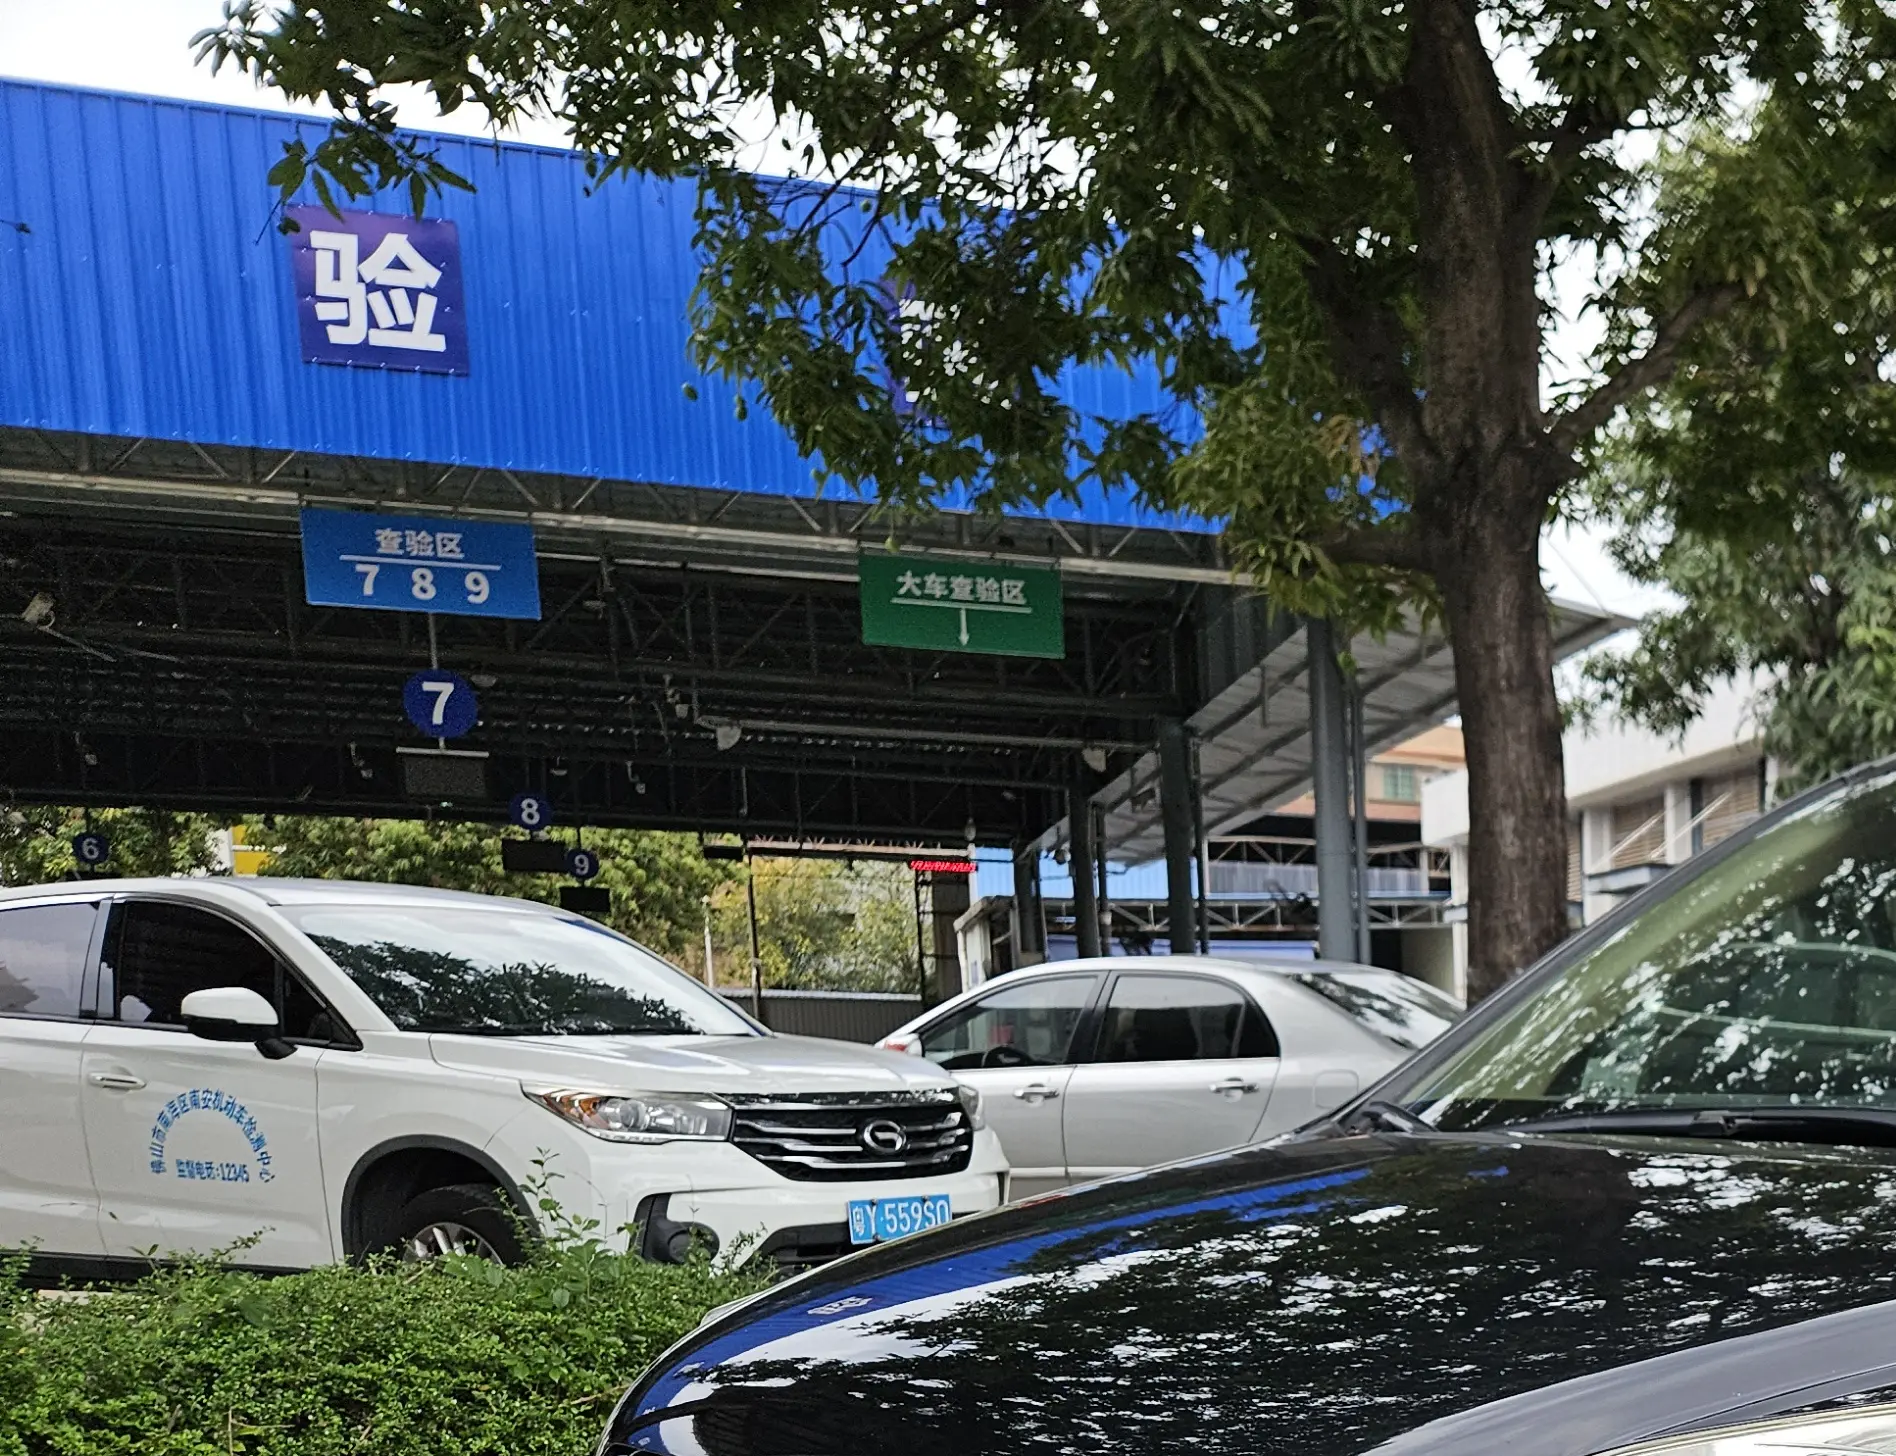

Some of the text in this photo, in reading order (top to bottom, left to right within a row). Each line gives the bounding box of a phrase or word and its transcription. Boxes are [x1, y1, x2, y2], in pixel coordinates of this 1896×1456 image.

[310, 230, 446, 352] 验
[375, 528, 465, 559] 查验区
[355, 563, 490, 604] 7 8 9
[896, 570, 1027, 605] 大车查验区
[422, 681, 455, 726] 7
[520, 798, 541, 825] 8
[82, 837, 100, 860] 6
[573, 854, 590, 876] 9
